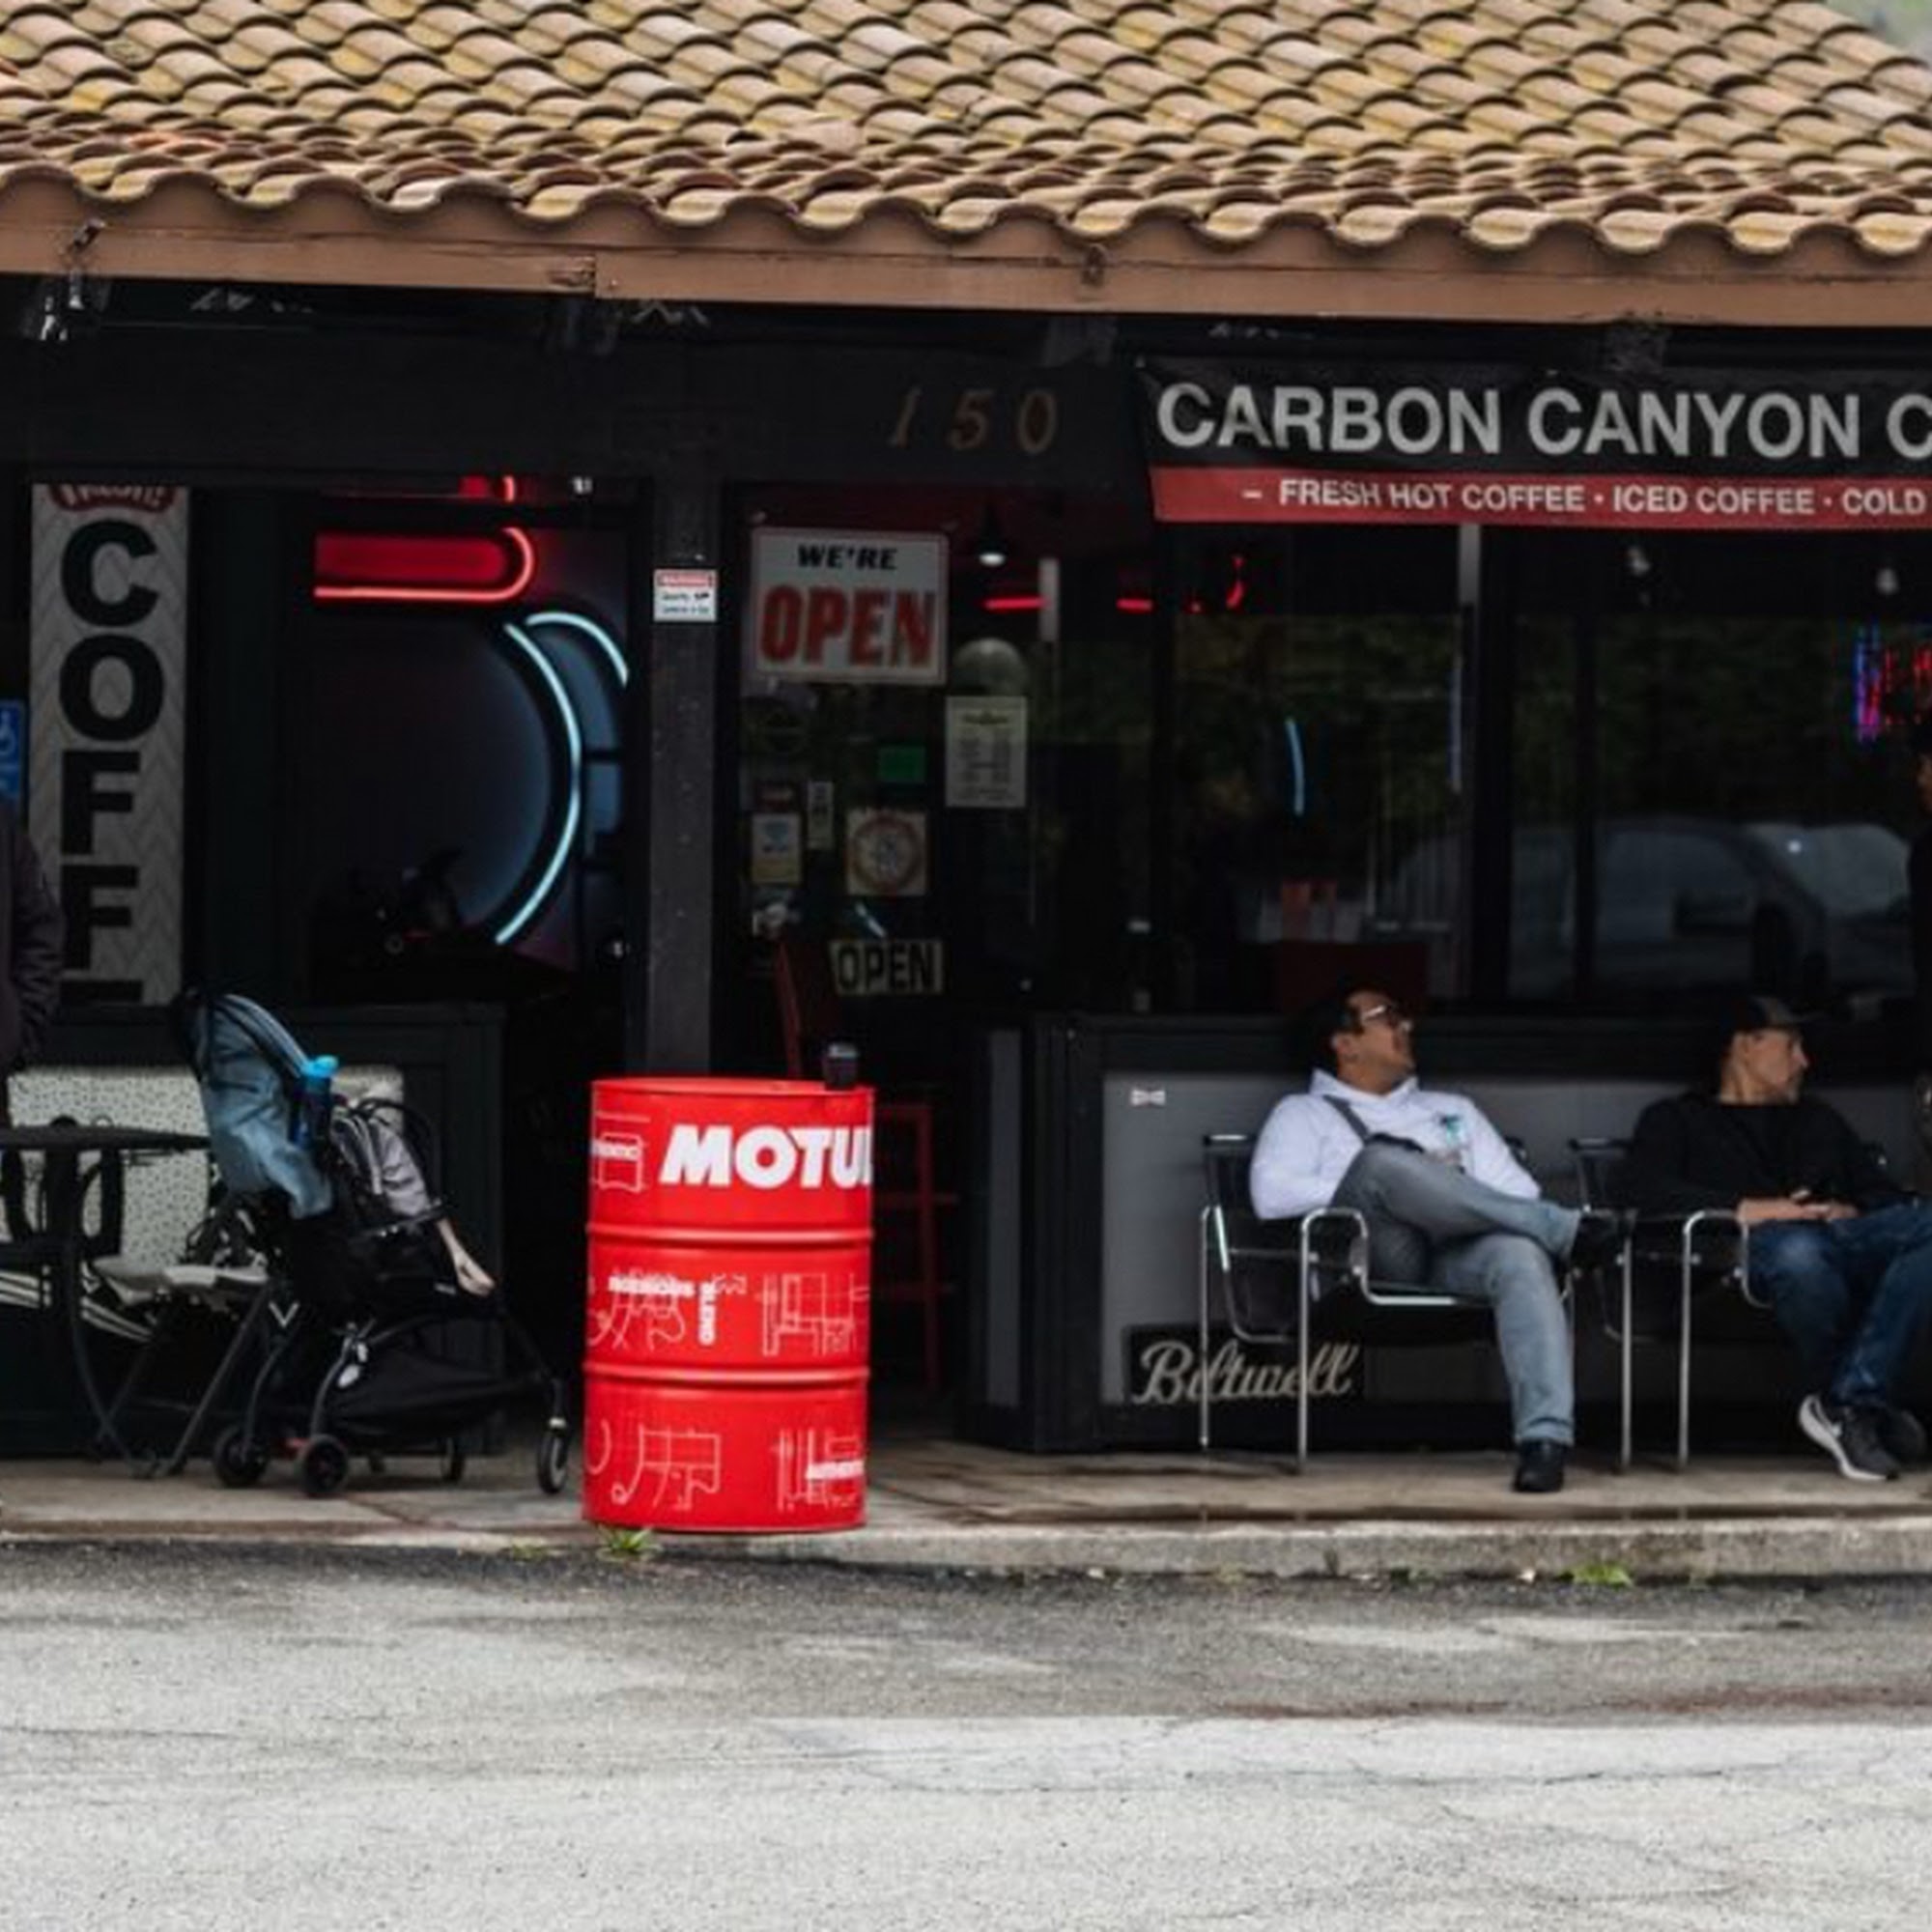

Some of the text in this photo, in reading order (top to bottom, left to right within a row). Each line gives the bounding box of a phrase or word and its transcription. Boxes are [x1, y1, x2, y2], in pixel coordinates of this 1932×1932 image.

[1157, 382, 1502, 454] CARBON
[1526, 387, 1861, 459] CANYON
[1278, 479, 1927, 516] FRESH HOT COFFEE ICED COFFEE COLD
[797, 542, 898, 571] WE'RE
[758, 583, 937, 669] OPEN
[58, 518, 166, 1004] COFF
[838, 945, 943, 993] OPEN
